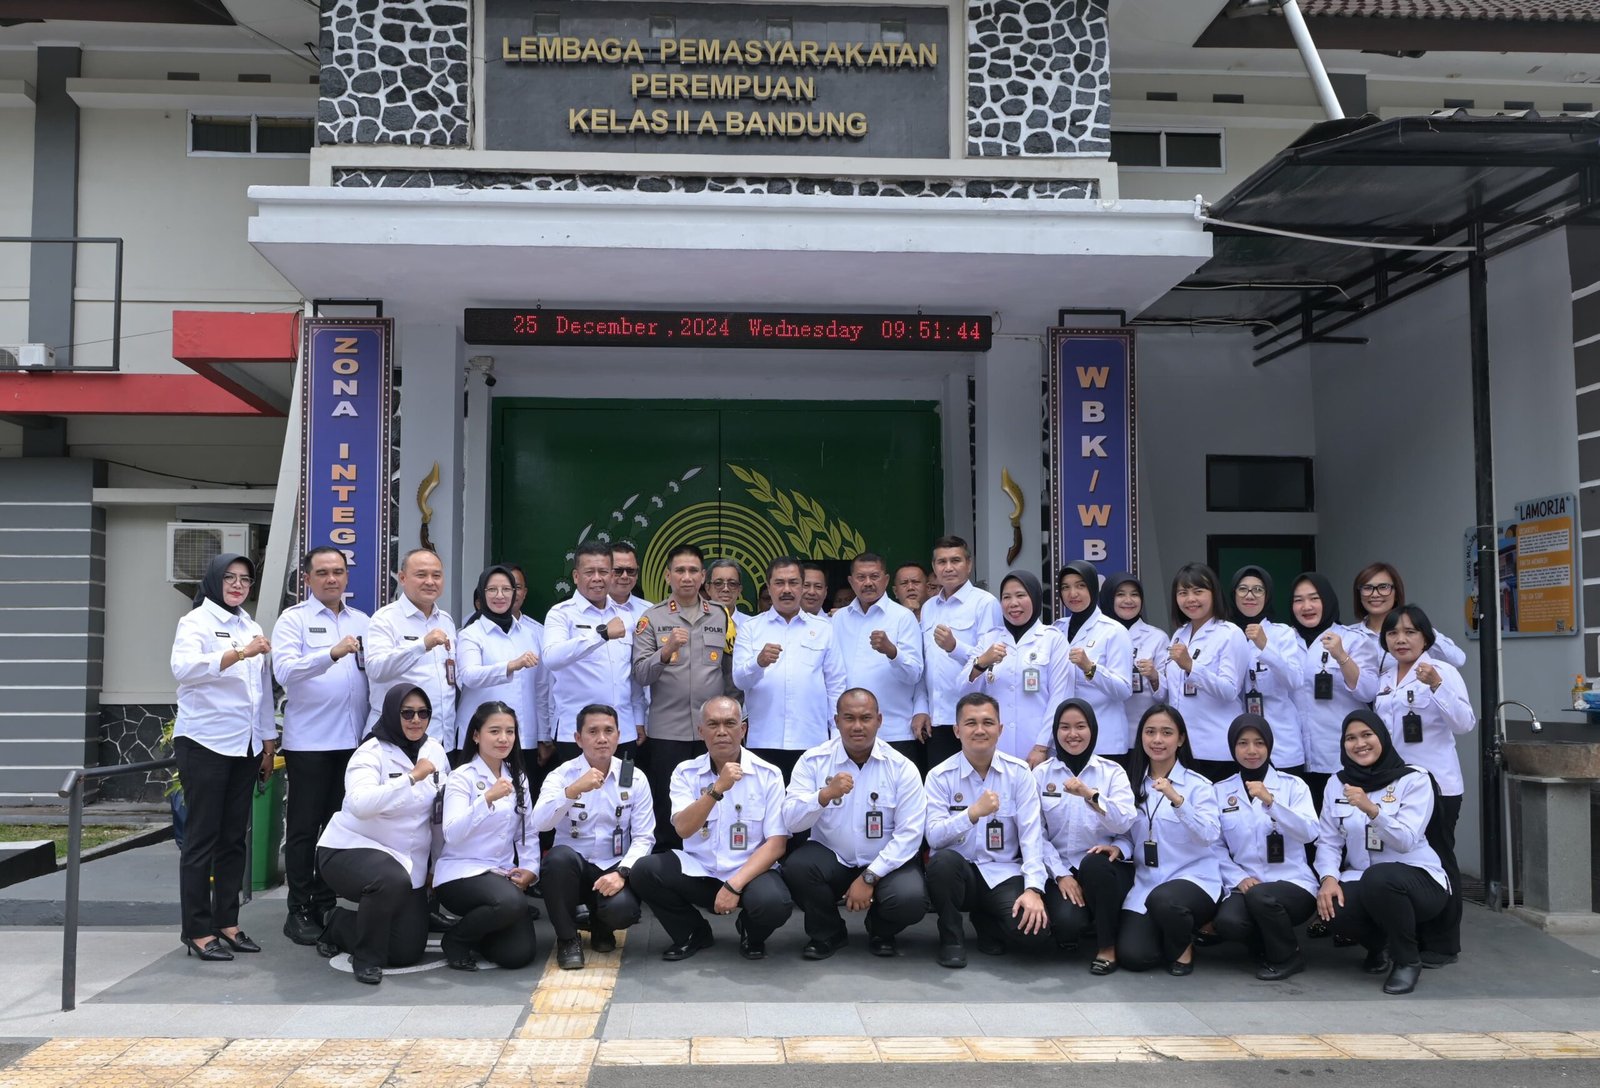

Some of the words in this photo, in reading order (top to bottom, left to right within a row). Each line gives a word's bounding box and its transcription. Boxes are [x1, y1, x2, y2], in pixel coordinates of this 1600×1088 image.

[502, 37, 644, 62] LEMBAGA
[660, 38, 938, 66] PEMASYARAKATAN
[631, 73, 815, 98] PEREMPUAN
[568, 109, 668, 132] KELAS
[676, 111, 689, 133] II
[697, 112, 718, 133] A
[726, 112, 868, 135] BANDUNG
[513, 315, 538, 334] 25
[556, 315, 658, 336] December
[748, 319, 863, 342] Wednesday
[881, 320, 981, 340] 09:51:44
[331, 337, 359, 417] ZONA
[1520, 497, 1565, 520] LAMORIA
